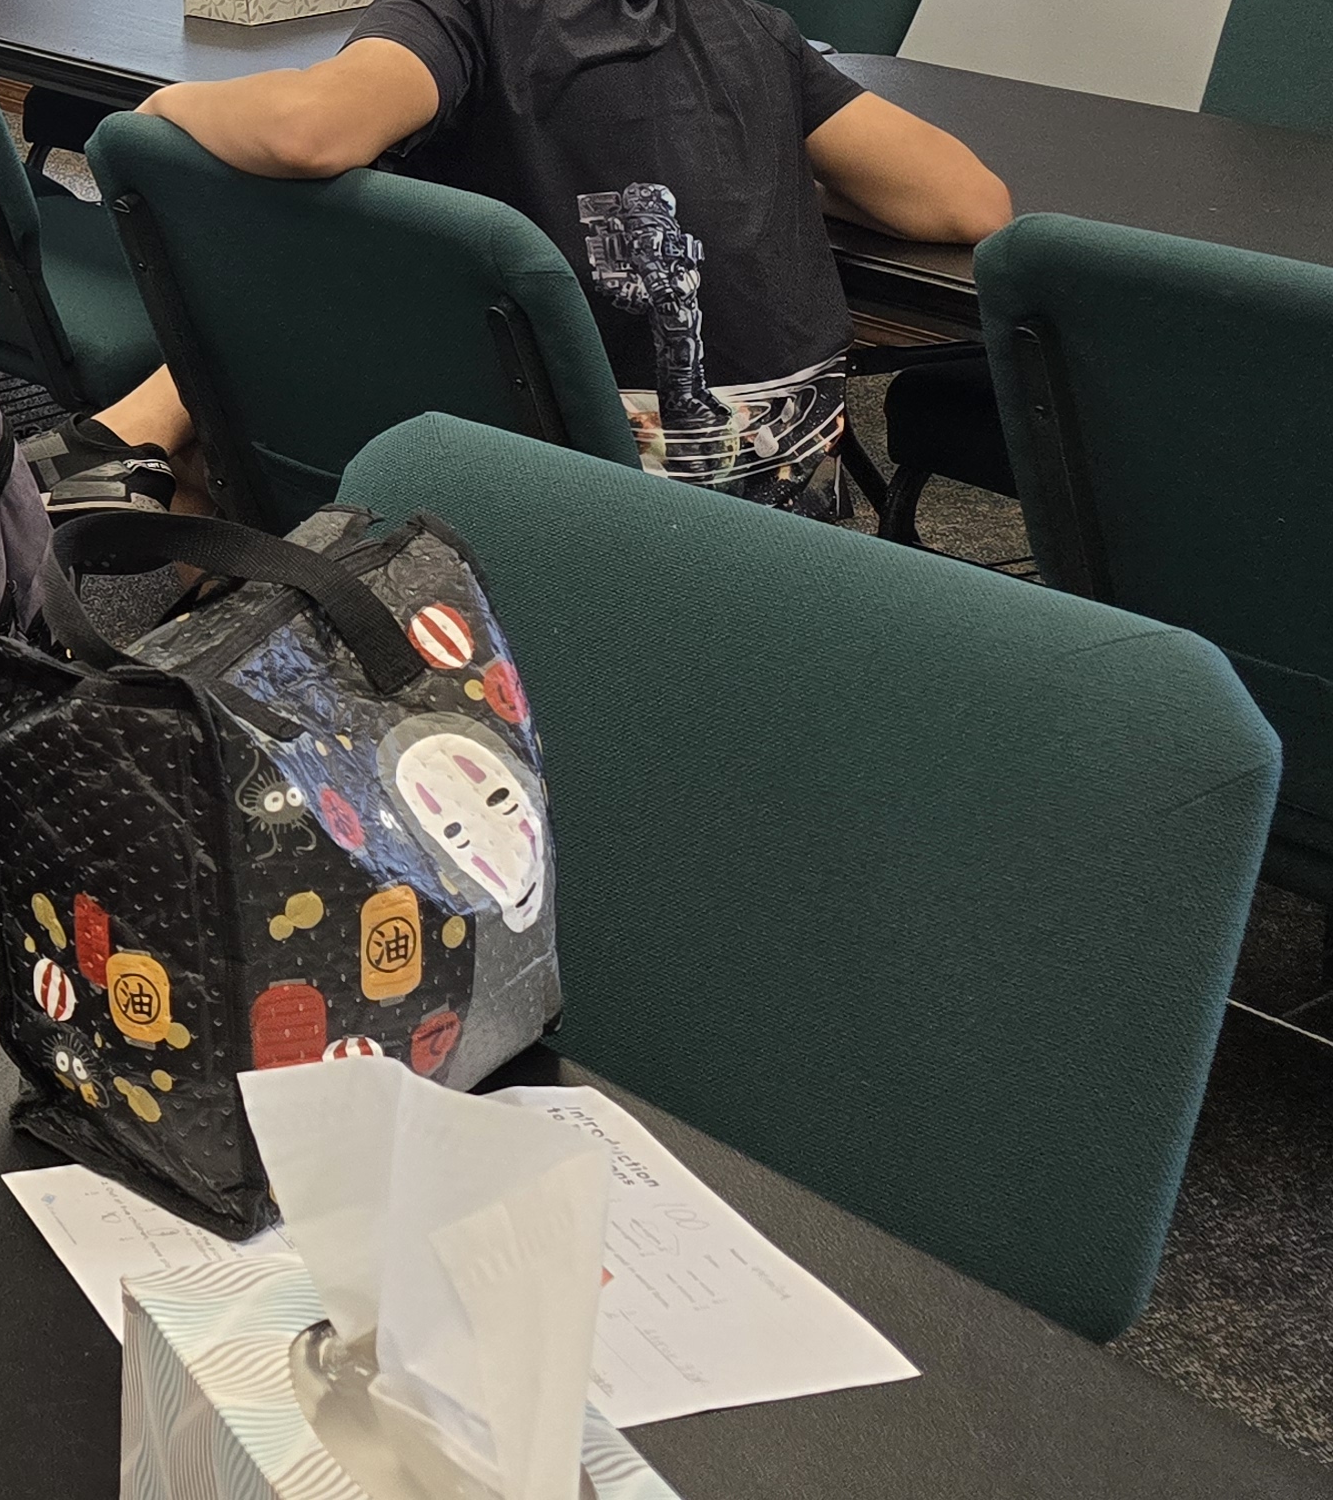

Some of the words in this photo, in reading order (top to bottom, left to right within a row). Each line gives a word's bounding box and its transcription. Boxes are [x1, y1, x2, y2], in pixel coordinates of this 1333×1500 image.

[374, 926, 410, 965] 油
[119, 981, 153, 1019] 油
[547, 1106, 565, 1122] to
